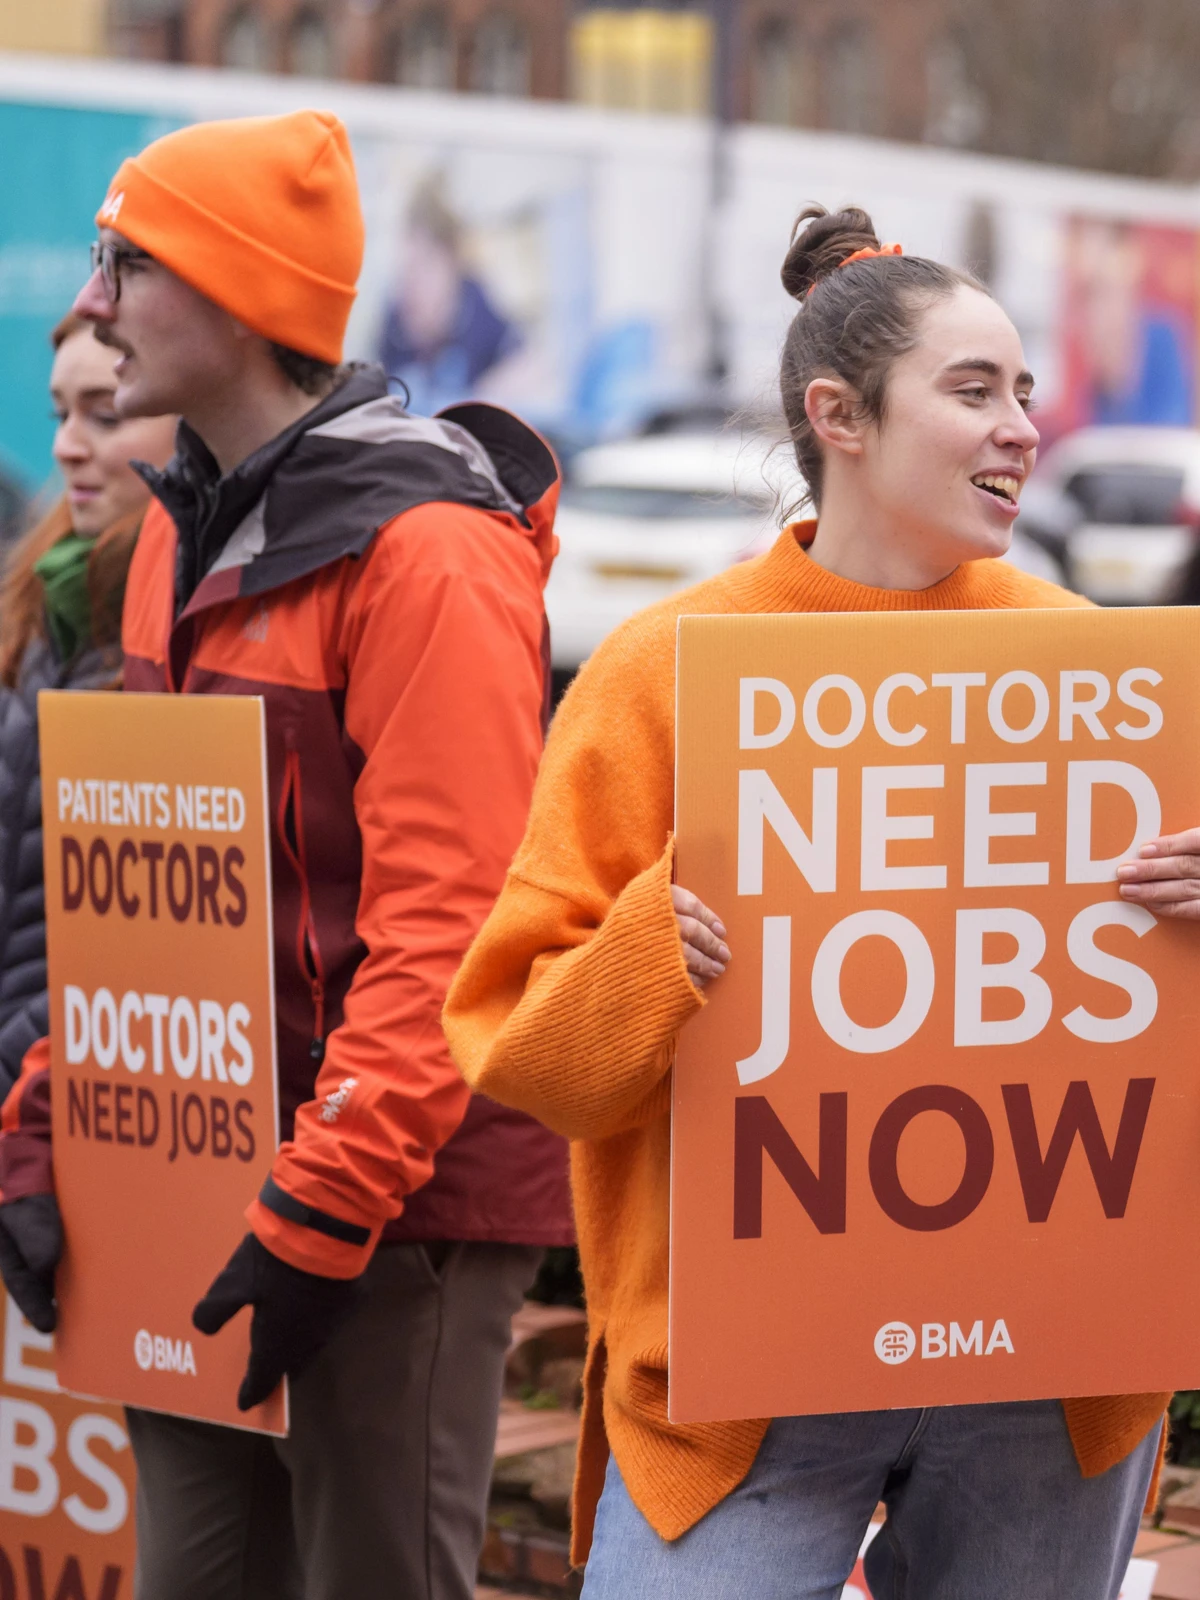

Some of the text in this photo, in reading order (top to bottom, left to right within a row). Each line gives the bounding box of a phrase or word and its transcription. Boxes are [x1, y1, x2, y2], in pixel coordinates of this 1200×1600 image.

[738, 667, 1164, 750] DOCTORS
[57, 777, 246, 833] PATIENTS NEED
[737, 760, 1162, 896] NEED
[60, 833, 247, 928] DOCTORS
[63, 984, 254, 1087] DOCTORS
[735, 901, 1160, 1086] JOBS
[66, 1077, 256, 1163] NEED JOBS
[732, 1077, 1157, 1240] NOW
[153, 1335, 197, 1377] BMA
[921, 1319, 1015, 1360] BMA
